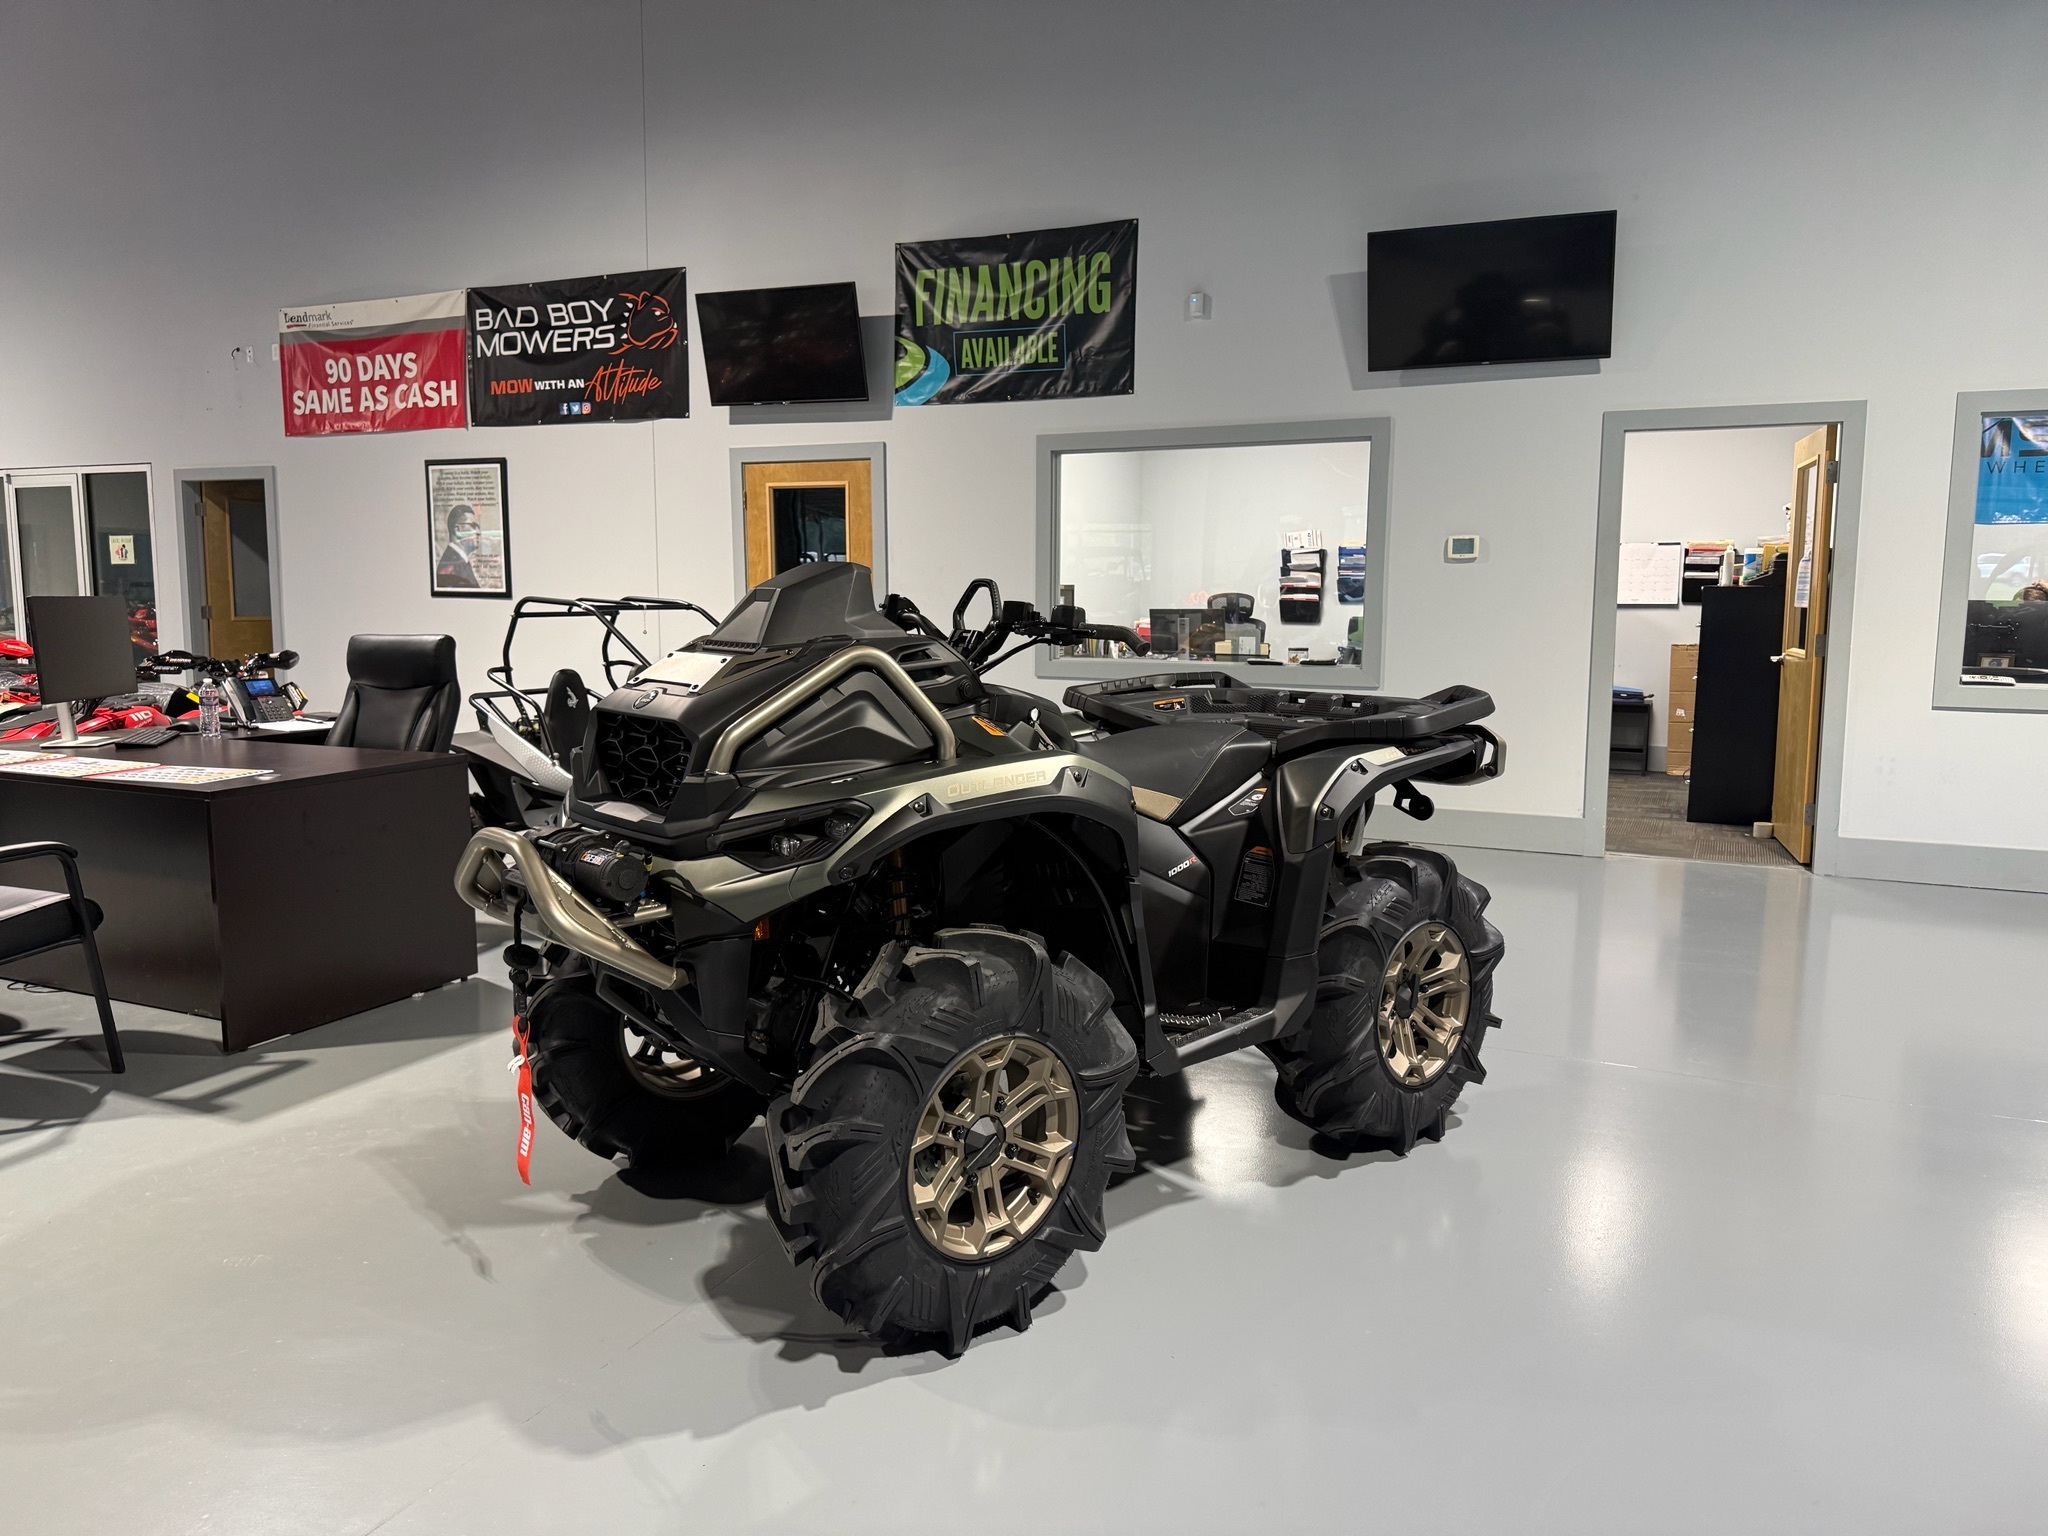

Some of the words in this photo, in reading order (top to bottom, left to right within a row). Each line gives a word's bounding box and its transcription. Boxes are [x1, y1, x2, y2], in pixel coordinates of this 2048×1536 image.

[915, 251, 1111, 327] FINANCING
[284, 310, 332, 323] Lendmark
[475, 306, 538, 331] BAD
[547, 297, 614, 326] BOY
[476, 324, 615, 358] MOWERS
[961, 331, 1058, 369] AVAILABLE
[325, 357, 351, 384] 90
[356, 352, 417, 382] DAYS
[491, 378, 533, 395] MOW
[534, 378, 565, 391] WITH
[568, 378, 585, 388] AN
[584, 358, 662, 405] Attitude
[292, 388, 353, 416] SAME
[360, 385, 388, 412] AS
[394, 379, 458, 410] CASH
[129, 710, 153, 722] 110
[947, 770, 1046, 798] OUTLANDER
[1168, 856, 1197, 877] 1000R
